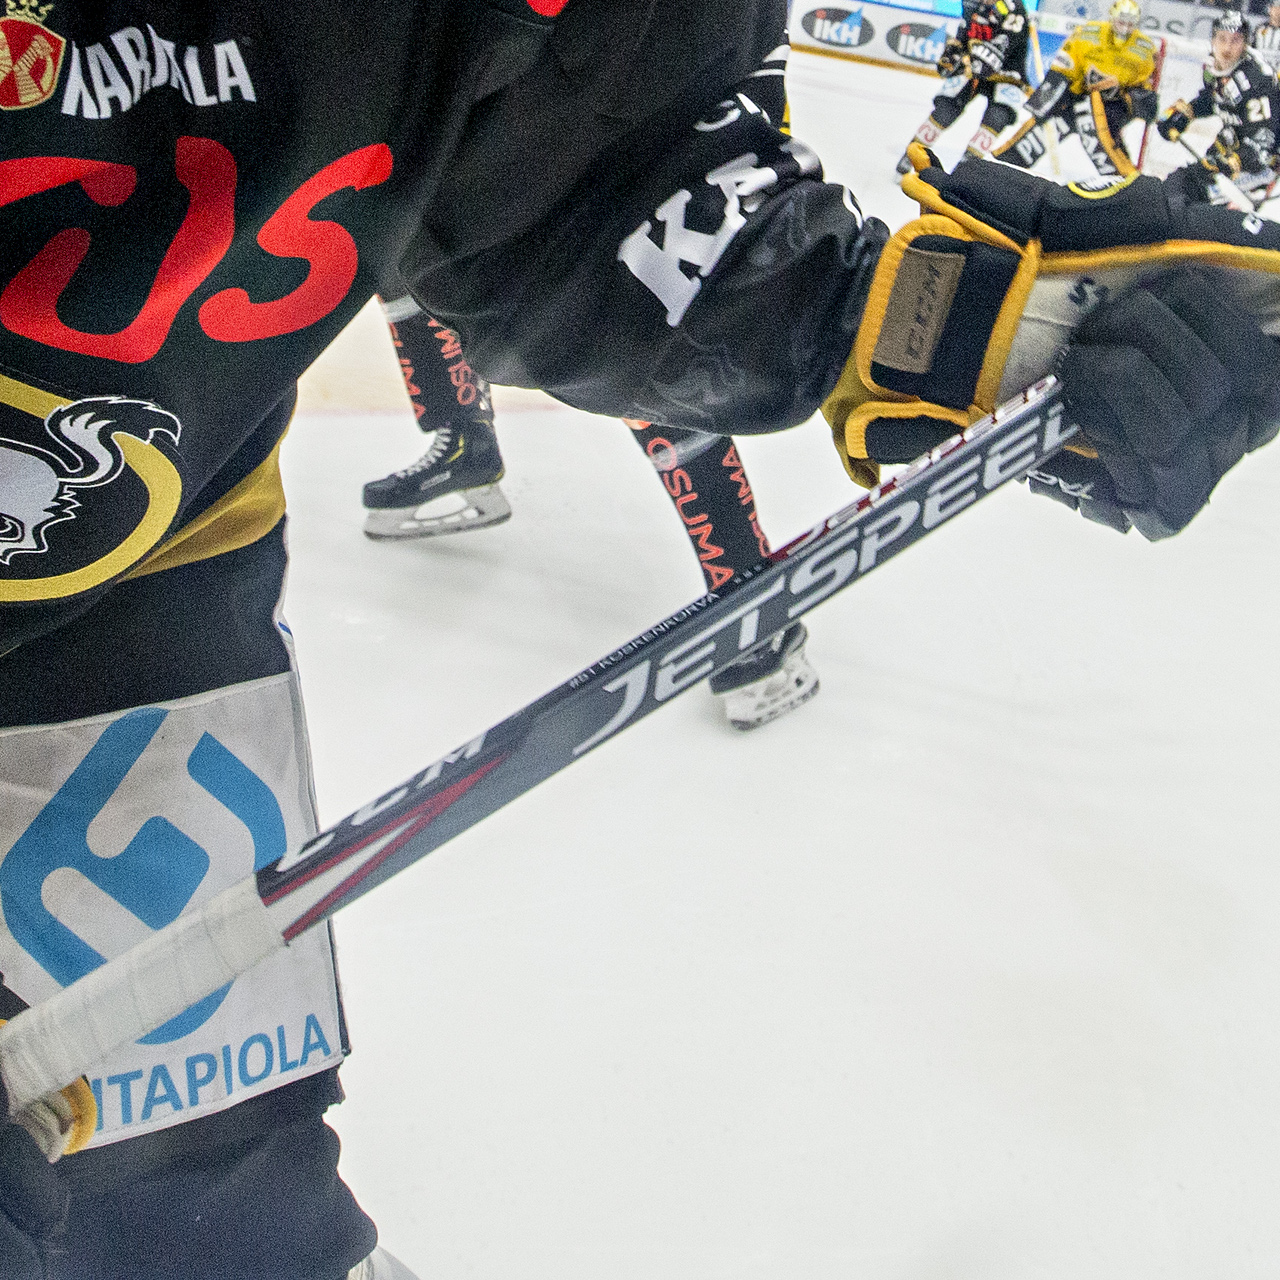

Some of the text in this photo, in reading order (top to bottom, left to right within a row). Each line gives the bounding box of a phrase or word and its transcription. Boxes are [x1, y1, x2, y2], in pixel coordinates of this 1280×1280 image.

[1247, 96, 1272, 122] 21
[647, 436, 735, 592] OSUMA
[91, 1012, 332, 1132] ITAPIOLA
